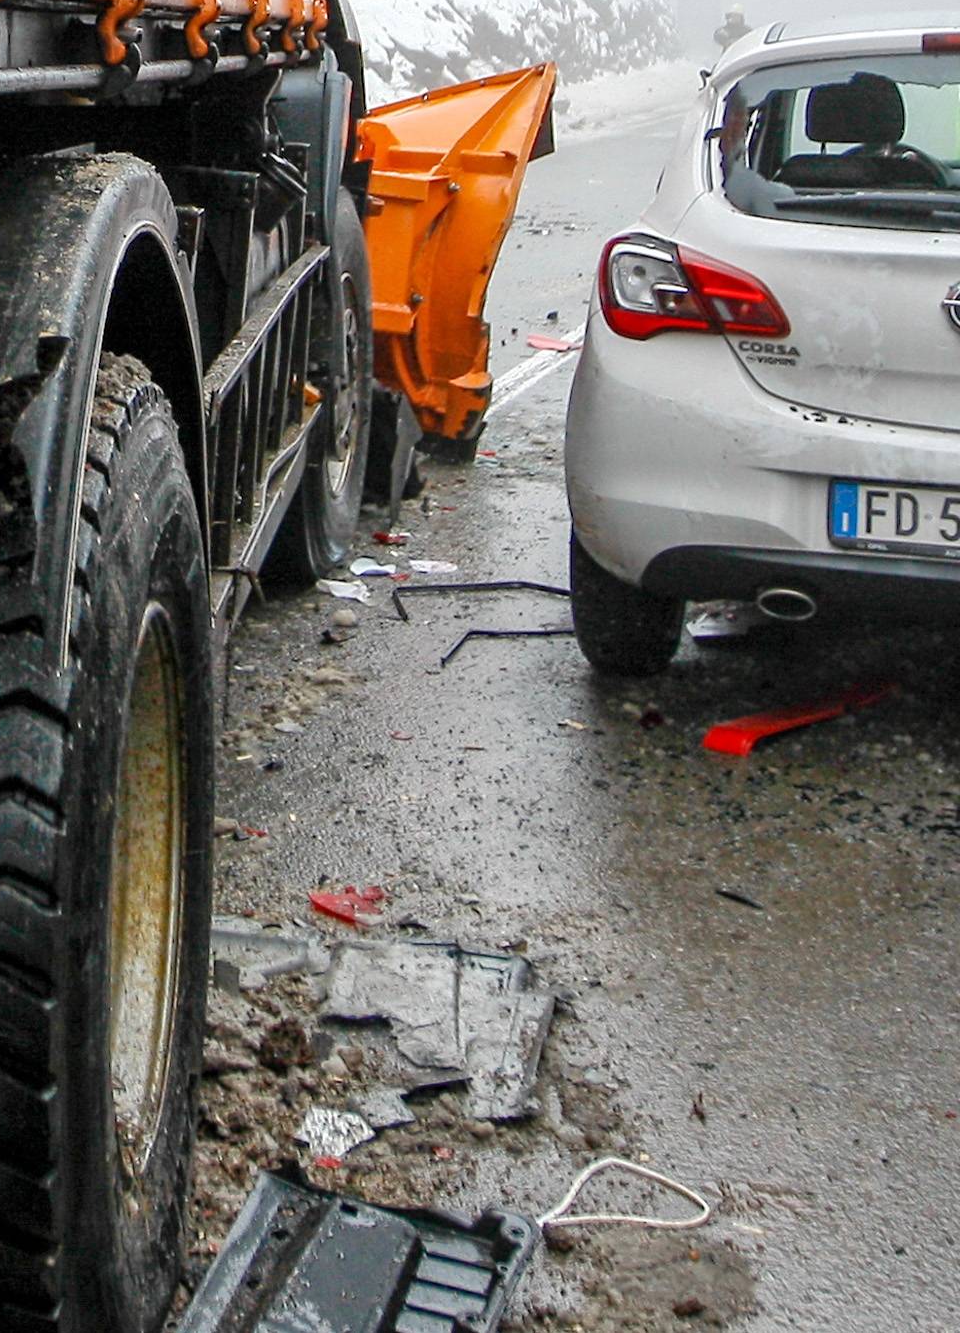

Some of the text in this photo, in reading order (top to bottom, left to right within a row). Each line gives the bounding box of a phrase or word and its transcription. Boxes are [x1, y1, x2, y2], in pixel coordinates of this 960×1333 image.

[738, 340, 801, 357] CORSA
[865, 490, 960, 542] FD 5
